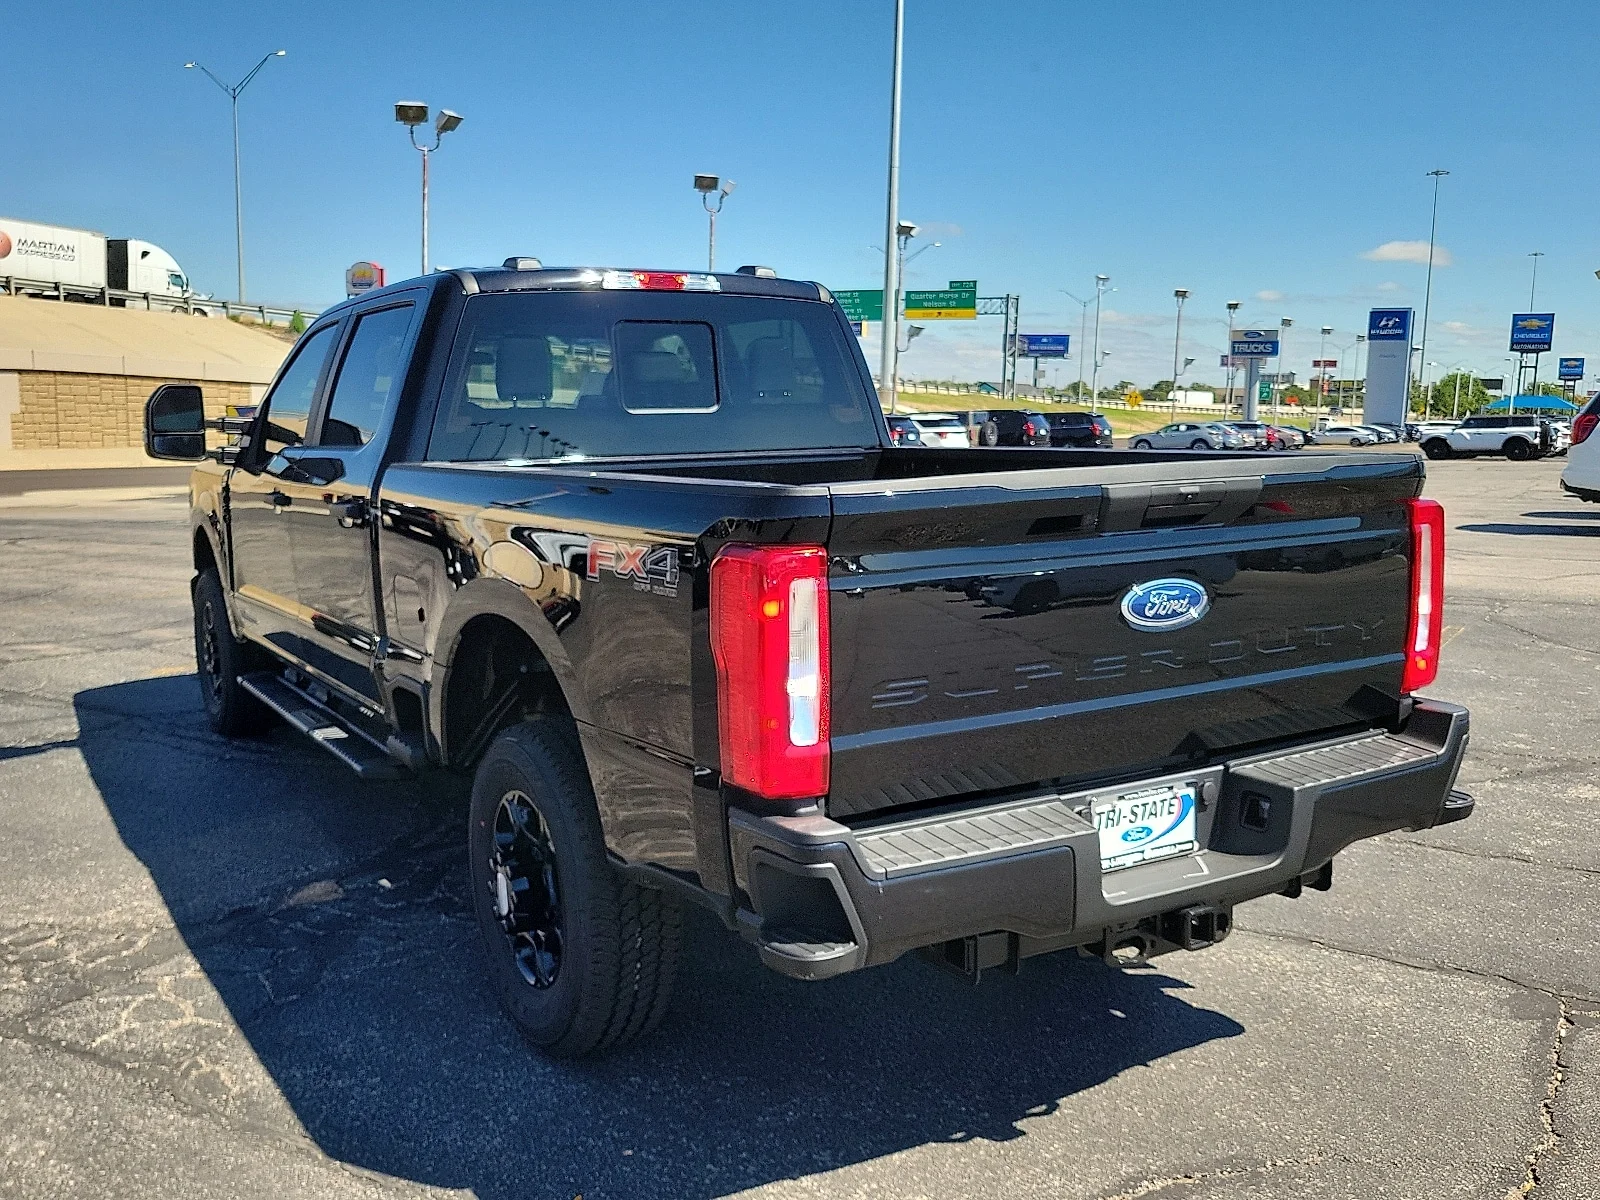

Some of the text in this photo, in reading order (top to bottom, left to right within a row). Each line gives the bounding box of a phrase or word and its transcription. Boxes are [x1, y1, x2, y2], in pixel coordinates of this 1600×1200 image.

[17, 238, 75, 253] MARTIAN
[938, 292, 959, 300] Horse
[1233, 343, 1272, 353] TRUCKS
[586, 538, 680, 588] FX4
[1143, 588, 1193, 618] Ford
[871, 617, 1386, 710] SUPER DUTY
[1094, 795, 1178, 832] TRI-STATE
